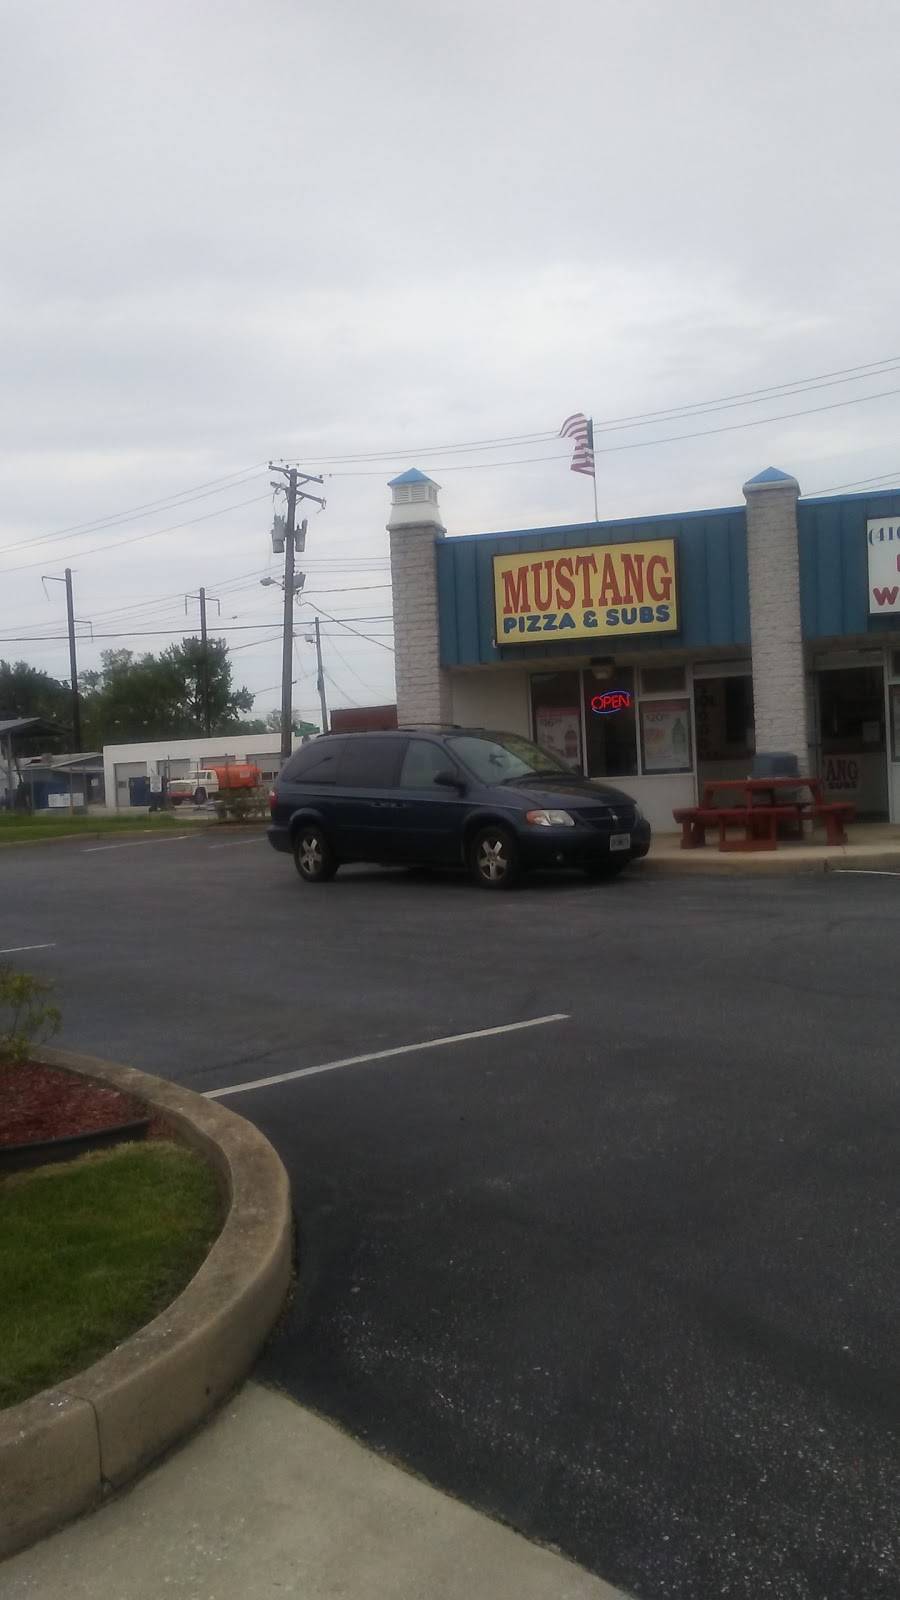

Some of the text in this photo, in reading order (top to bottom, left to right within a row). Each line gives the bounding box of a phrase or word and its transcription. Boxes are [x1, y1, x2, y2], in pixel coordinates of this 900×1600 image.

[501, 552, 673, 615] MUSTANG
[503, 604, 671, 634] PIZZA & SUBS
[591, 694, 630, 709] OPEN
